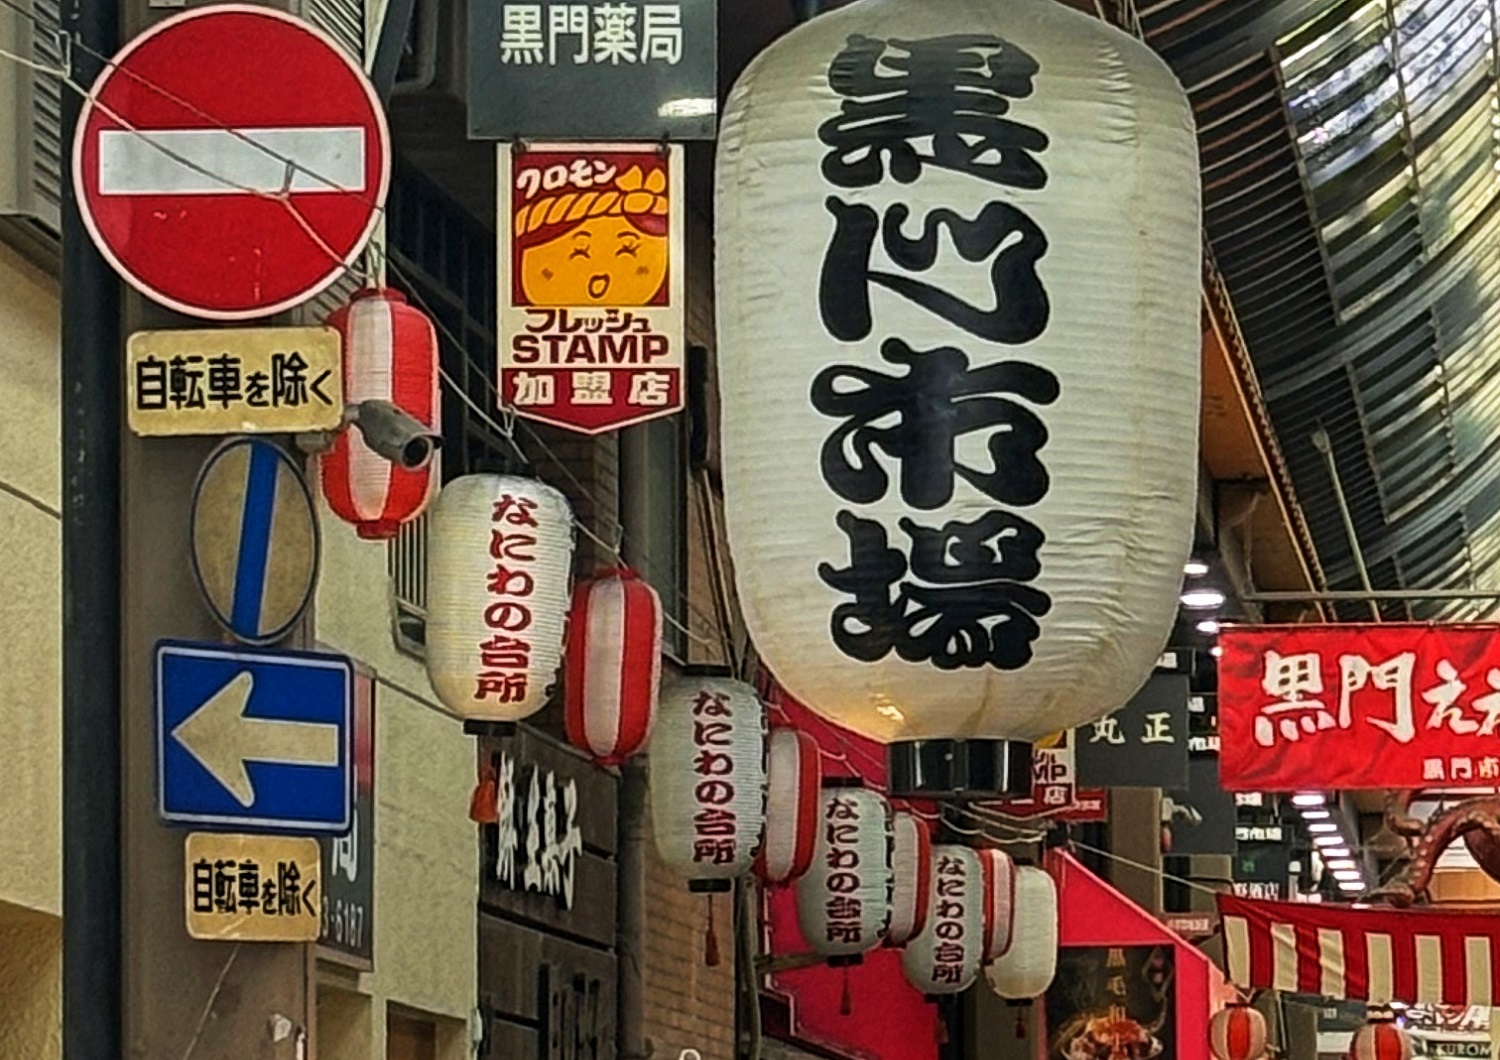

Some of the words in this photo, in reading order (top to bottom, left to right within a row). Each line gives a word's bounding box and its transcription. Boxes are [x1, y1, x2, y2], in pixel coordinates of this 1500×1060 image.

[500, 3, 684, 66] 黒門薬局
[515, 158, 616, 197] クロモン
[511, 335, 670, 364] STAMP
[523, 309, 651, 333] フレッシュ
[134, 352, 335, 411] 自転車を除く
[512, 371, 672, 406] 加盟店
[472, 493, 540, 704] なにわの台所
[692, 690, 738, 866] なにわの台所
[192, 858, 318, 918] 自転車を除く
[825, 797, 863, 944] なにわの台所
[930, 854, 968, 985] なにわの台所
